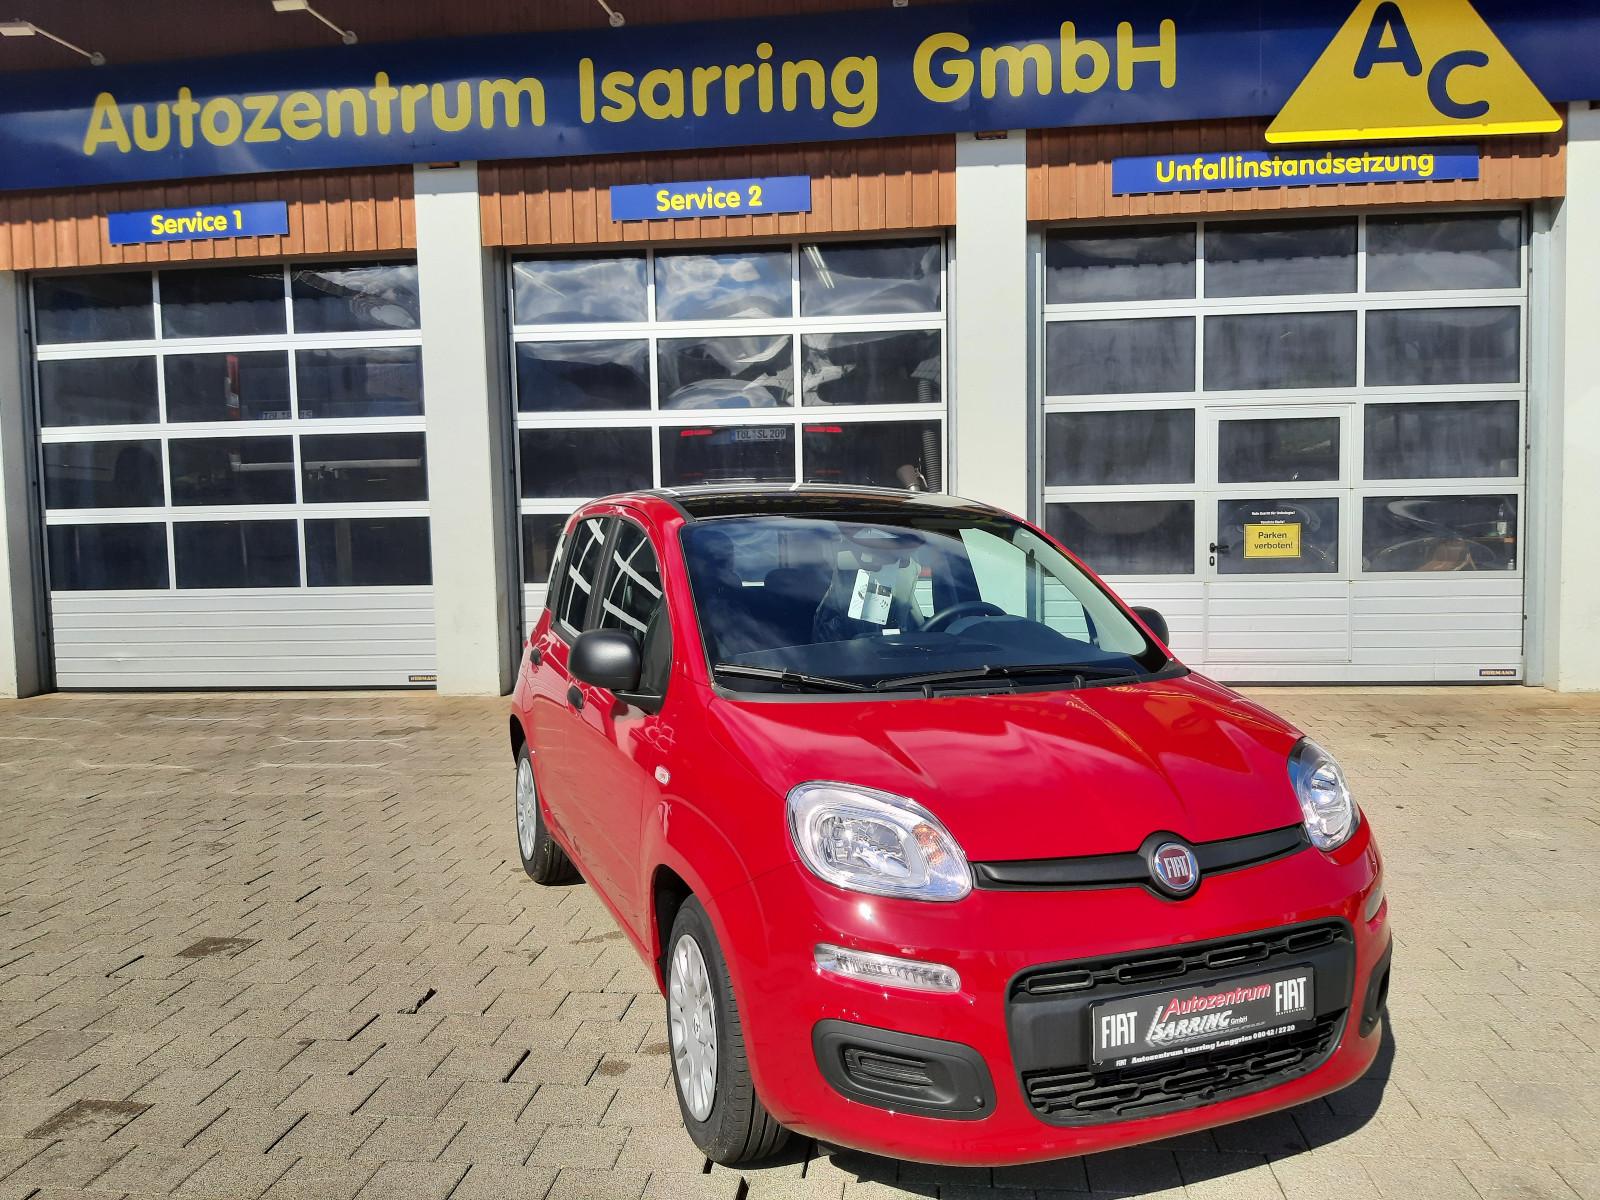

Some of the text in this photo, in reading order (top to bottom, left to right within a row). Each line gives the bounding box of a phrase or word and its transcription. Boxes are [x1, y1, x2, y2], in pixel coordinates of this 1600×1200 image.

[83, 18, 1178, 156] Autozentrum Isarring GmbH
[1156, 151, 1435, 184] Unfallinstandsetzung
[656, 185, 763, 213] Service 2
[151, 210, 242, 236] Service 1
[1254, 542, 1293, 550] verboten!
[1258, 531, 1287, 539] Parken
[1163, 855, 1189, 879] FIAT
[1159, 983, 1272, 1023] Autozentrum
[1275, 977, 1307, 1013] FIAT
[1101, 1011, 1138, 1049] FIAT
[1230, 1015, 1248, 1025] GmbH
[1115, 1058, 1127, 1067] FIAT
[1131, 1049, 1184, 1064] Autozentrum
[1184, 1042, 1216, 1054] Isarring
